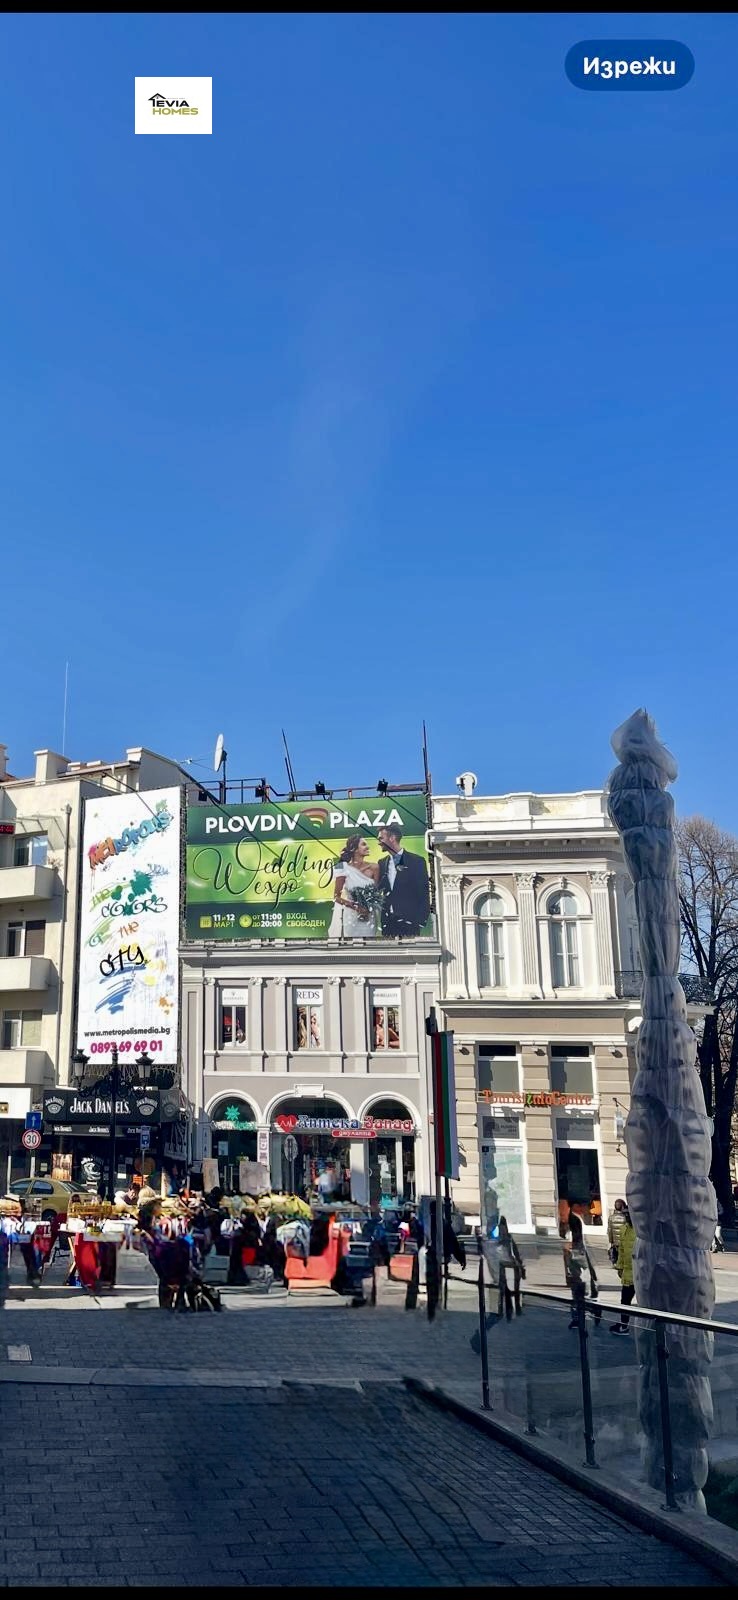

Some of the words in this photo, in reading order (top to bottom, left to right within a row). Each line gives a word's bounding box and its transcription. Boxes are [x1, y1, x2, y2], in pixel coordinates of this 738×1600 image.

[205, 813, 300, 833] PLOVDIV
[330, 809, 404, 829] PLAZA
[192, 836, 336, 895] Wedding
[254, 878, 300, 910] expo
[212, 914, 221, 922] 11
[226, 913, 236, 921] 12
[260, 913, 282, 921] 11:00
[286, 912, 307, 920] ВХОД
[260, 920, 282, 928] 20:00
[285, 919, 326, 928] СВОБОДЕН
[84, 1026, 171, 1037] www.metropolismedia.bg
[118, 1041, 132, 1052] 69
[134, 1040, 148, 1052] 69
[149, 1040, 163, 1052] 01
[70, 1097, 93, 1113] JACK
[95, 1097, 129, 1114] DANEL'S
[26, 1134, 37, 1144] 30
